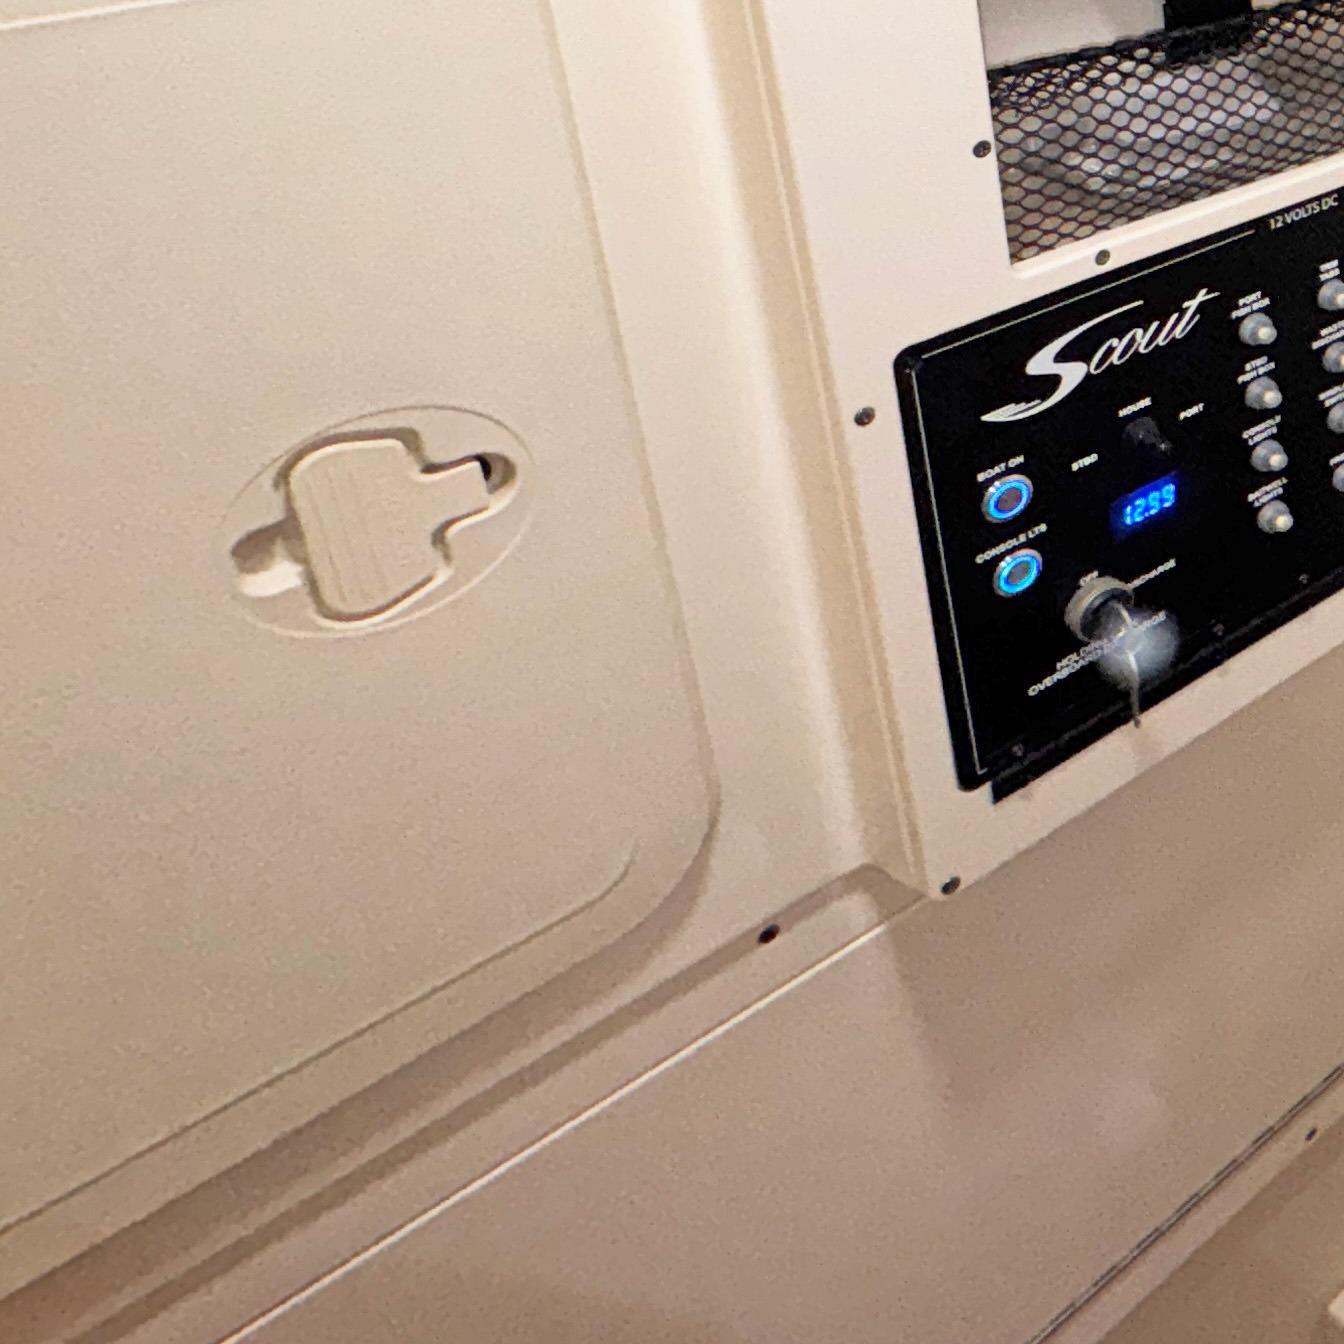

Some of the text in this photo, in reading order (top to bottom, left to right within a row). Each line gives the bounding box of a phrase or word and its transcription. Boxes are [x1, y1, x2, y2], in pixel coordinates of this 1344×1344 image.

[1269, 194, 1340, 232] 12 VOLTS DC
[979, 287, 1221, 423] Scout
[1118, 396, 1152, 418] HOUSE
[1179, 402, 1205, 421] PORT
[976, 454, 1025, 483] BOAT ON
[1071, 453, 1099, 472] STBD
[1123, 483, 1177, 526] 12.99
[974, 522, 1048, 565] CONSOLE LTS
